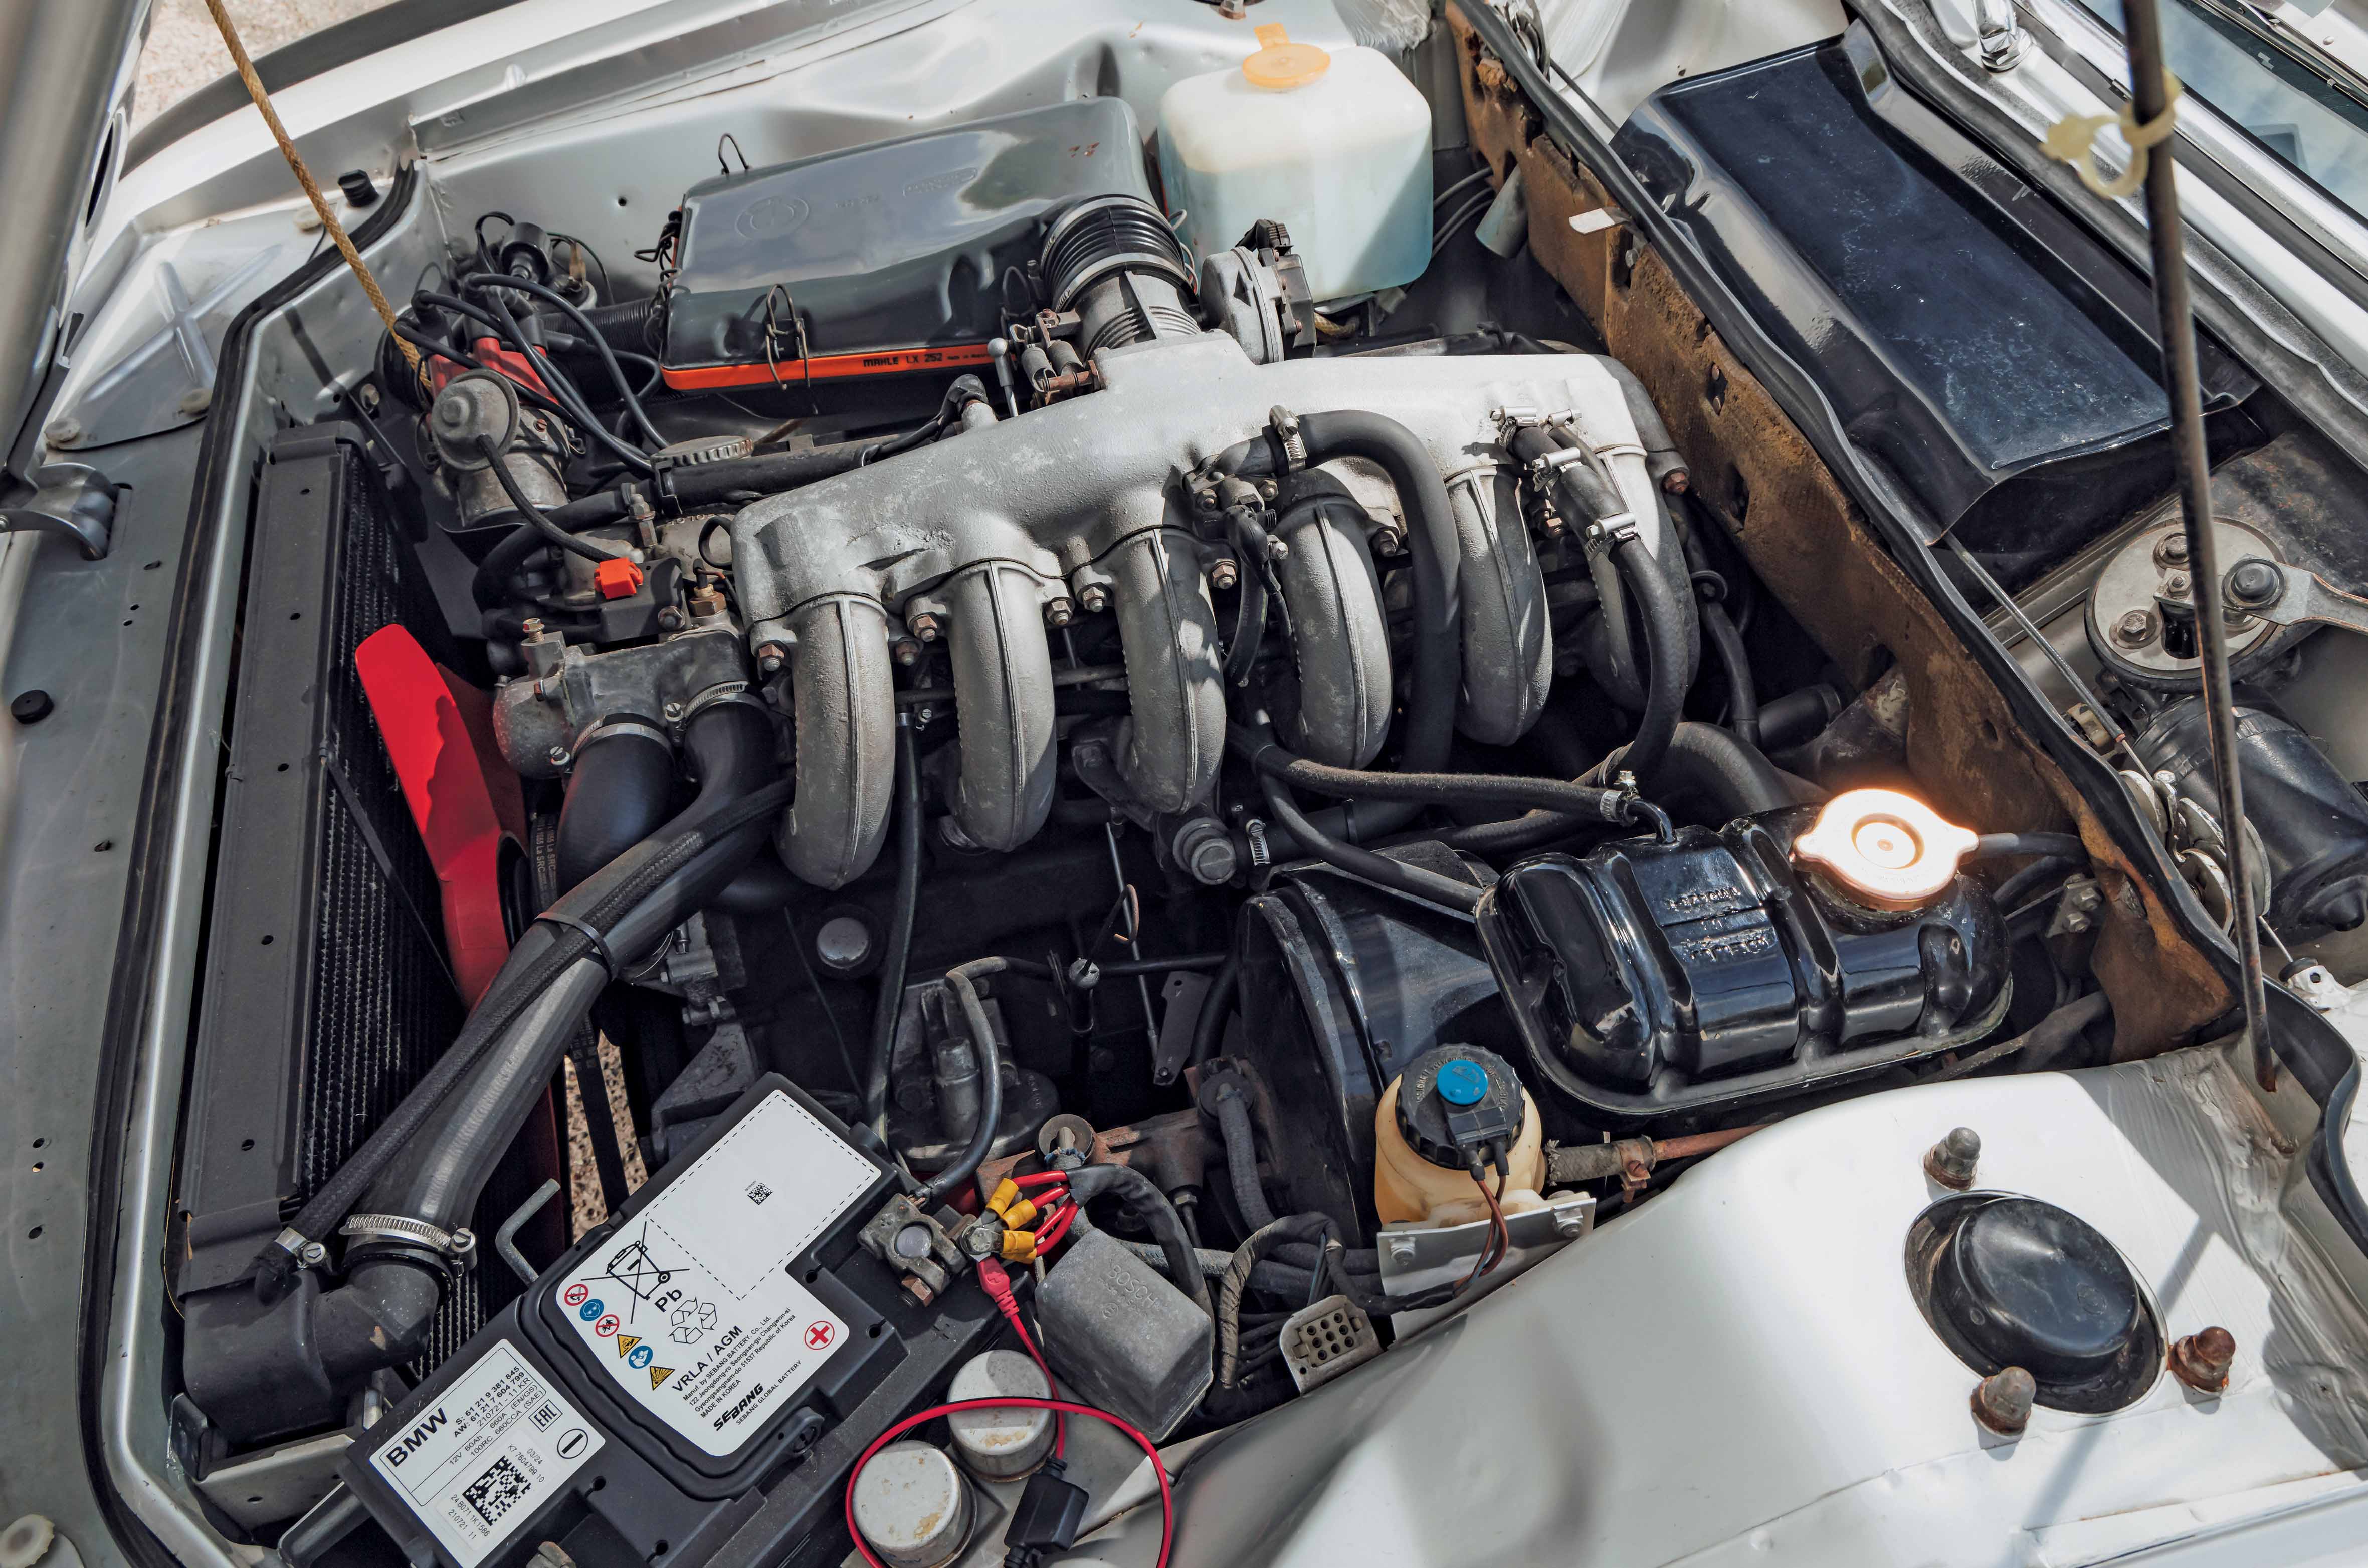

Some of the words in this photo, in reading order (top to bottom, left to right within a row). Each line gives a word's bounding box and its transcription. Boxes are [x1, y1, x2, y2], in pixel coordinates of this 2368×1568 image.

[863, 356, 899, 367] MAHLE
[906, 354, 919, 363] LX
[924, 352, 943, 362] 252
[654, 1289, 682, 1313] Pb
[1107, 1264, 1158, 1309] BOSCH
[672, 1361, 708, 1392] VRLA
[707, 1353, 713, 1362] /
[714, 1325, 742, 1357] AGM
[683, 1385, 701, 1401] Manuf.
[700, 1378, 708, 1386] by
[706, 1357, 728, 1379] SEBANG
[760, 1316, 771, 1326] Ltd.
[689, 1396, 699, 1406] 122
[698, 1366, 732, 1398] Jeongdong-ro
[730, 1337, 762, 1367] Seongsan-gu
[760, 1307, 791, 1337] Changwon-si
[695, 1366, 742, 1413] Gyeongsangnam-do
[741, 1353, 756, 1368] 51537
[754, 1333, 777, 1355] Republic
[780, 1315, 796, 1330] Korea
[454, 1422, 470, 1438] AW:
[470, 1413, 480, 1422] 61
[481, 1404, 490, 1413] 21
[497, 1384, 510, 1398] 604
[511, 1372, 524, 1386] 799
[456, 1416, 465, 1425] S:
[465, 1407, 474, 1417] 61
[475, 1398, 485, 1407] 21
[491, 1380, 505, 1392] 381
[505, 1366, 519, 1380] 845
[477, 1402, 502, 1427] 210721
[509, 1388, 517, 1397] 11
[519, 1377, 531, 1389] KR
[700, 1402, 717, 1419] MADE
[716, 1396, 723, 1404] IN
[722, 1379, 741, 1398] KOREA
[713, 1383, 764, 1432] SEBANG
[736, 1403, 758, 1425] SEBANG
[758, 1383, 779, 1404] GLOBAL
[778, 1360, 802, 1383] BATTERY
[386, 1408, 448, 1467] BMW
[450, 1452, 462, 1465] 12V
[465, 1435, 482, 1451] 60Ah
[490, 1413, 508, 1428] 660A
[511, 1384, 537, 1410] (EN/GS)
[471, 1436, 493, 1457] 100RC
[495, 1410, 522, 1435] 660CCA
[524, 1390, 543, 1409] (SAE)
[508, 1444, 517, 1453] K7
[515, 1452, 538, 1475] 7604799
[536, 1474, 544, 1483] 10
[527, 1448, 543, 1465] 03/24
[448, 1509, 468, 1530] 210721
